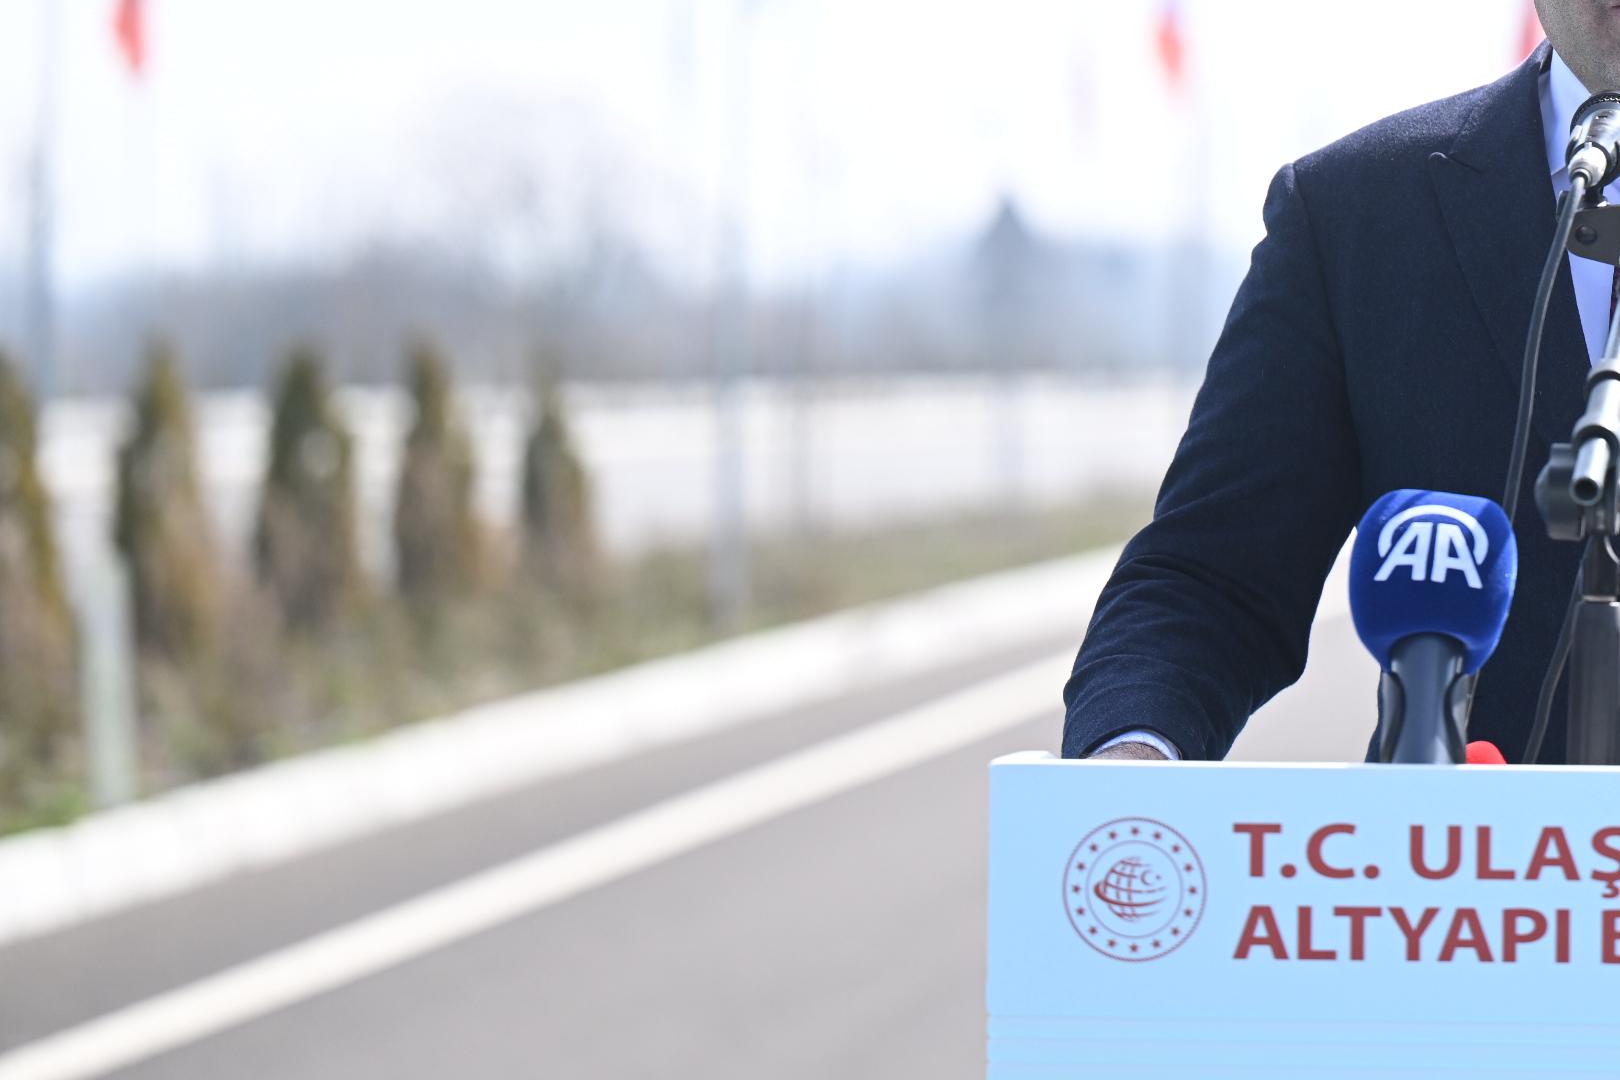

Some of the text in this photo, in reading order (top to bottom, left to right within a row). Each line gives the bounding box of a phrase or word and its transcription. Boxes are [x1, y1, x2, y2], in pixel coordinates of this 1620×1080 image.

[1373, 521, 1483, 589] AA
[1233, 822, 1381, 879] T.C.
[1233, 904, 1571, 964] ALTYAPI
